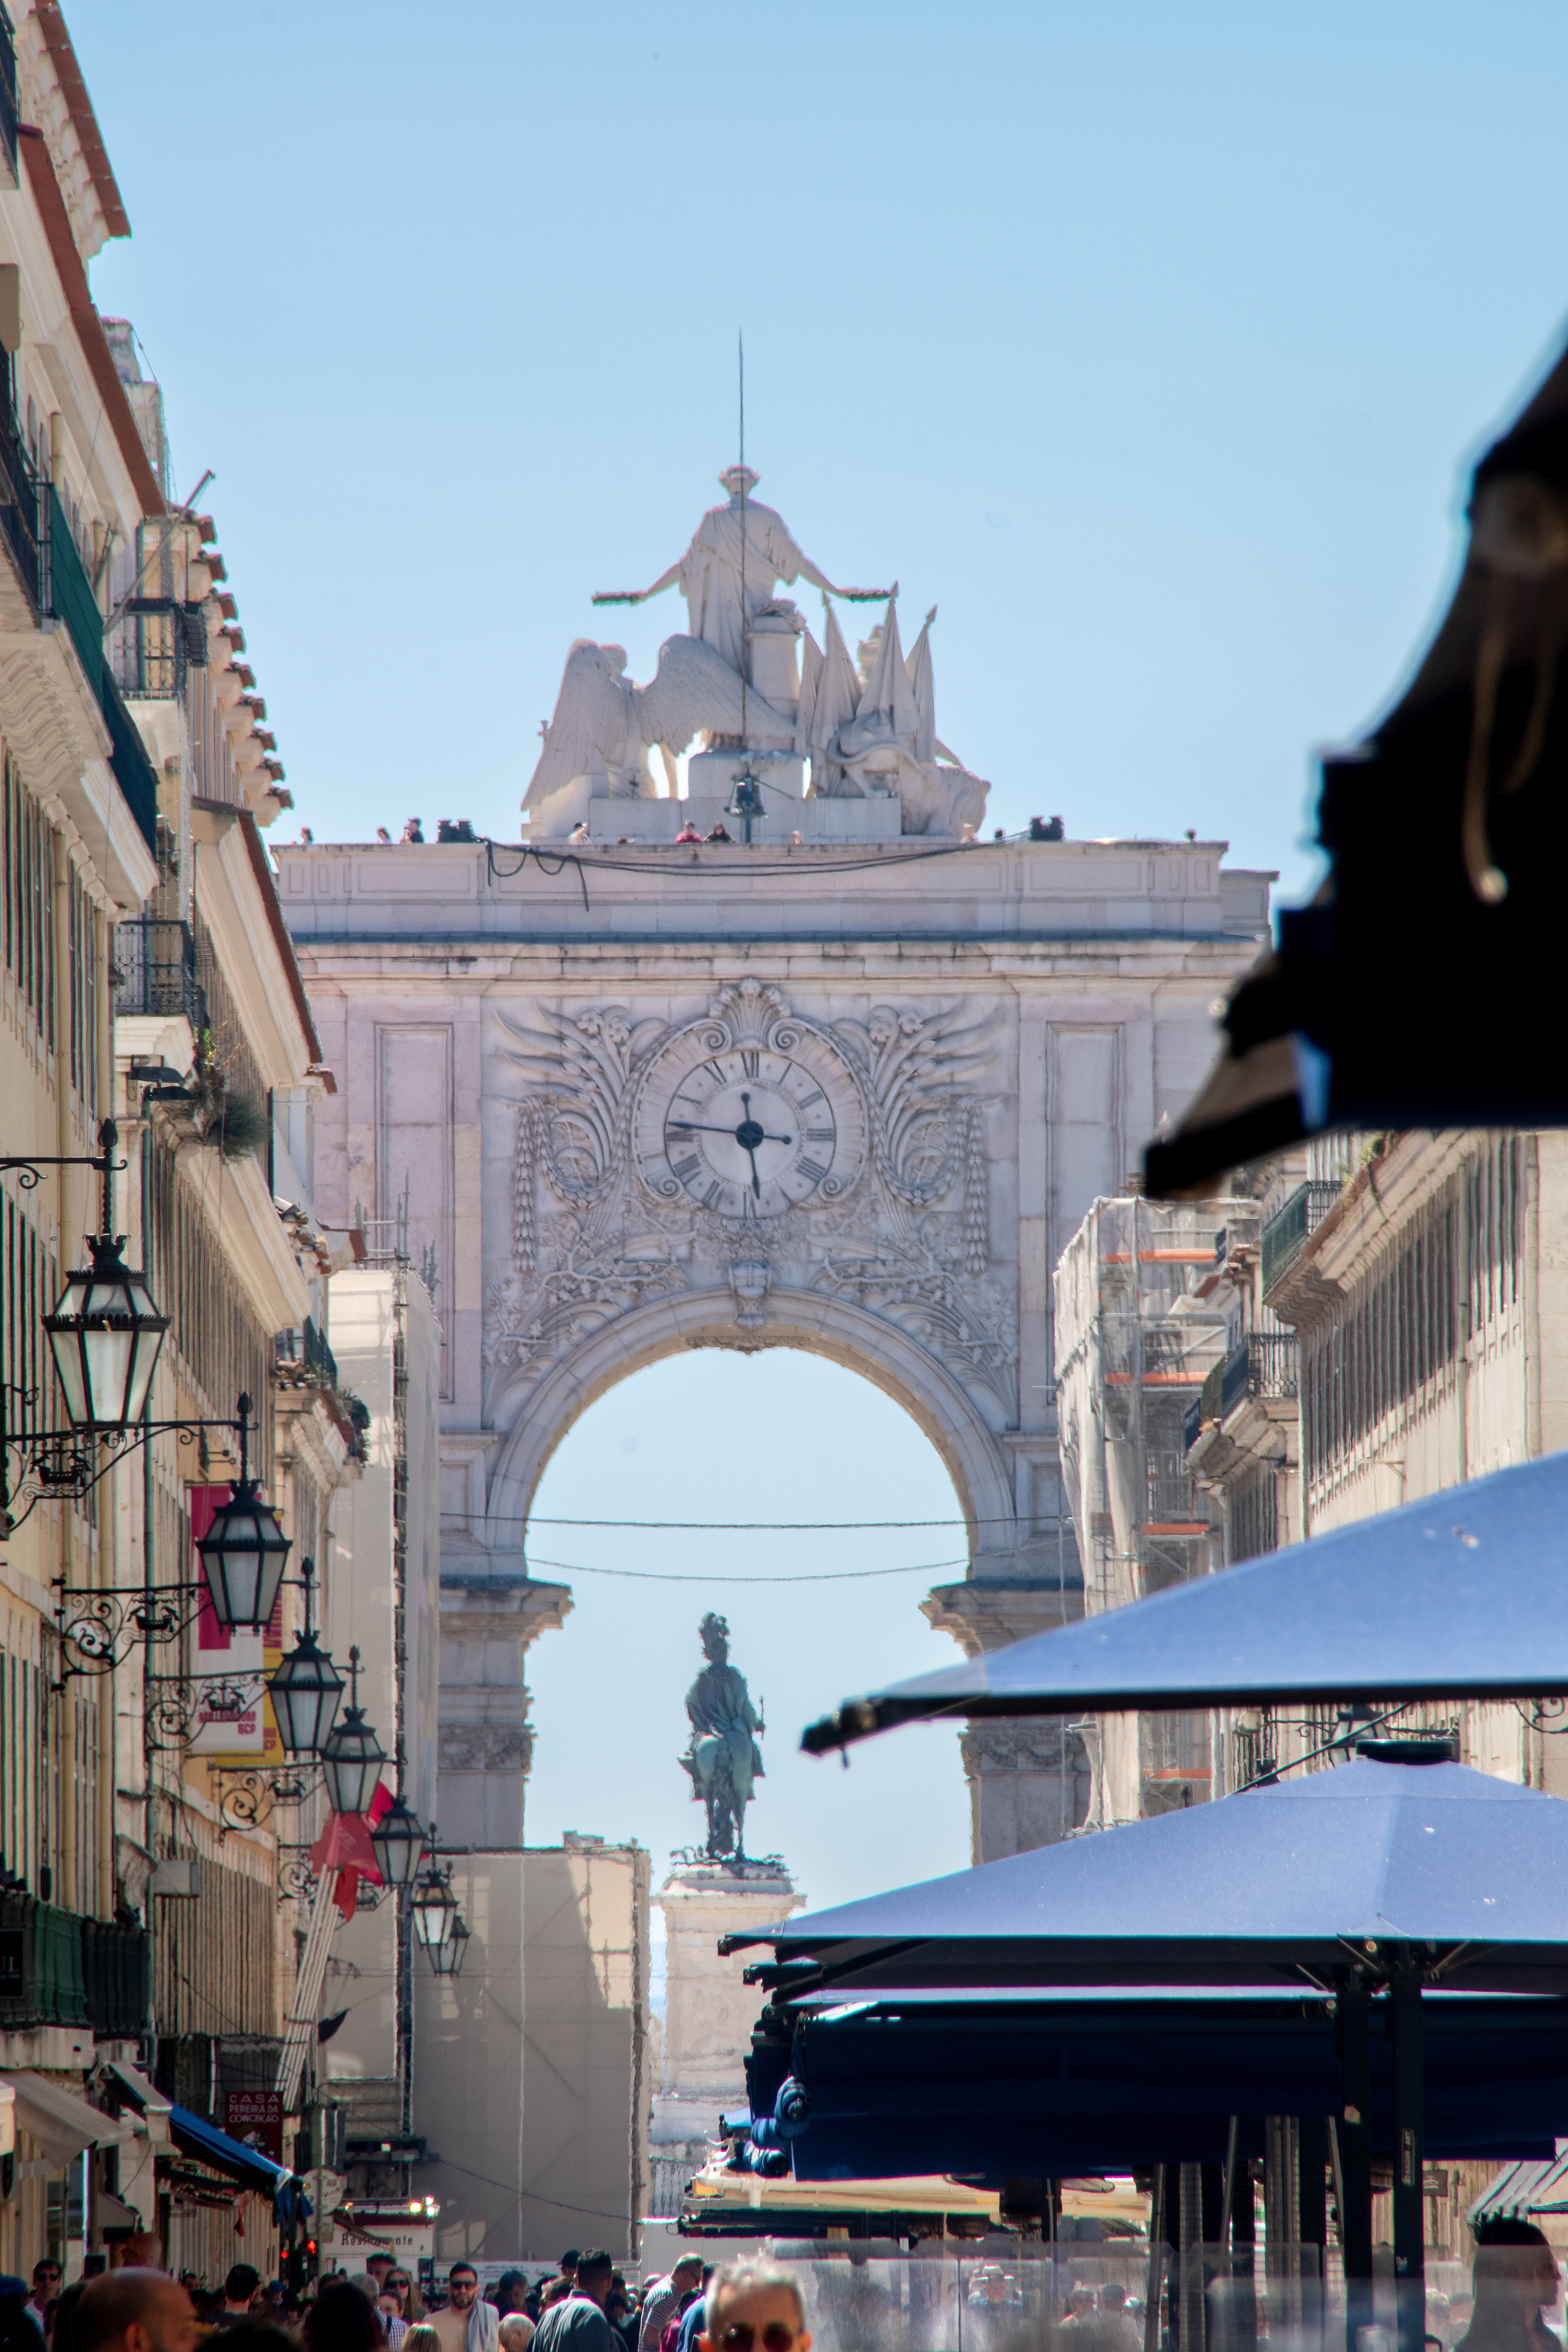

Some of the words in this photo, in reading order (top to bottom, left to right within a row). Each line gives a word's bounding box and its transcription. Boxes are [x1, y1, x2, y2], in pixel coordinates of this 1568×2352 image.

[229, 2094, 279, 2103] CASA
[229, 2105, 266, 2113] PEREIRA
[267, 2105, 278, 2113] DA
[341, 2232, 413, 2245] Resnte
